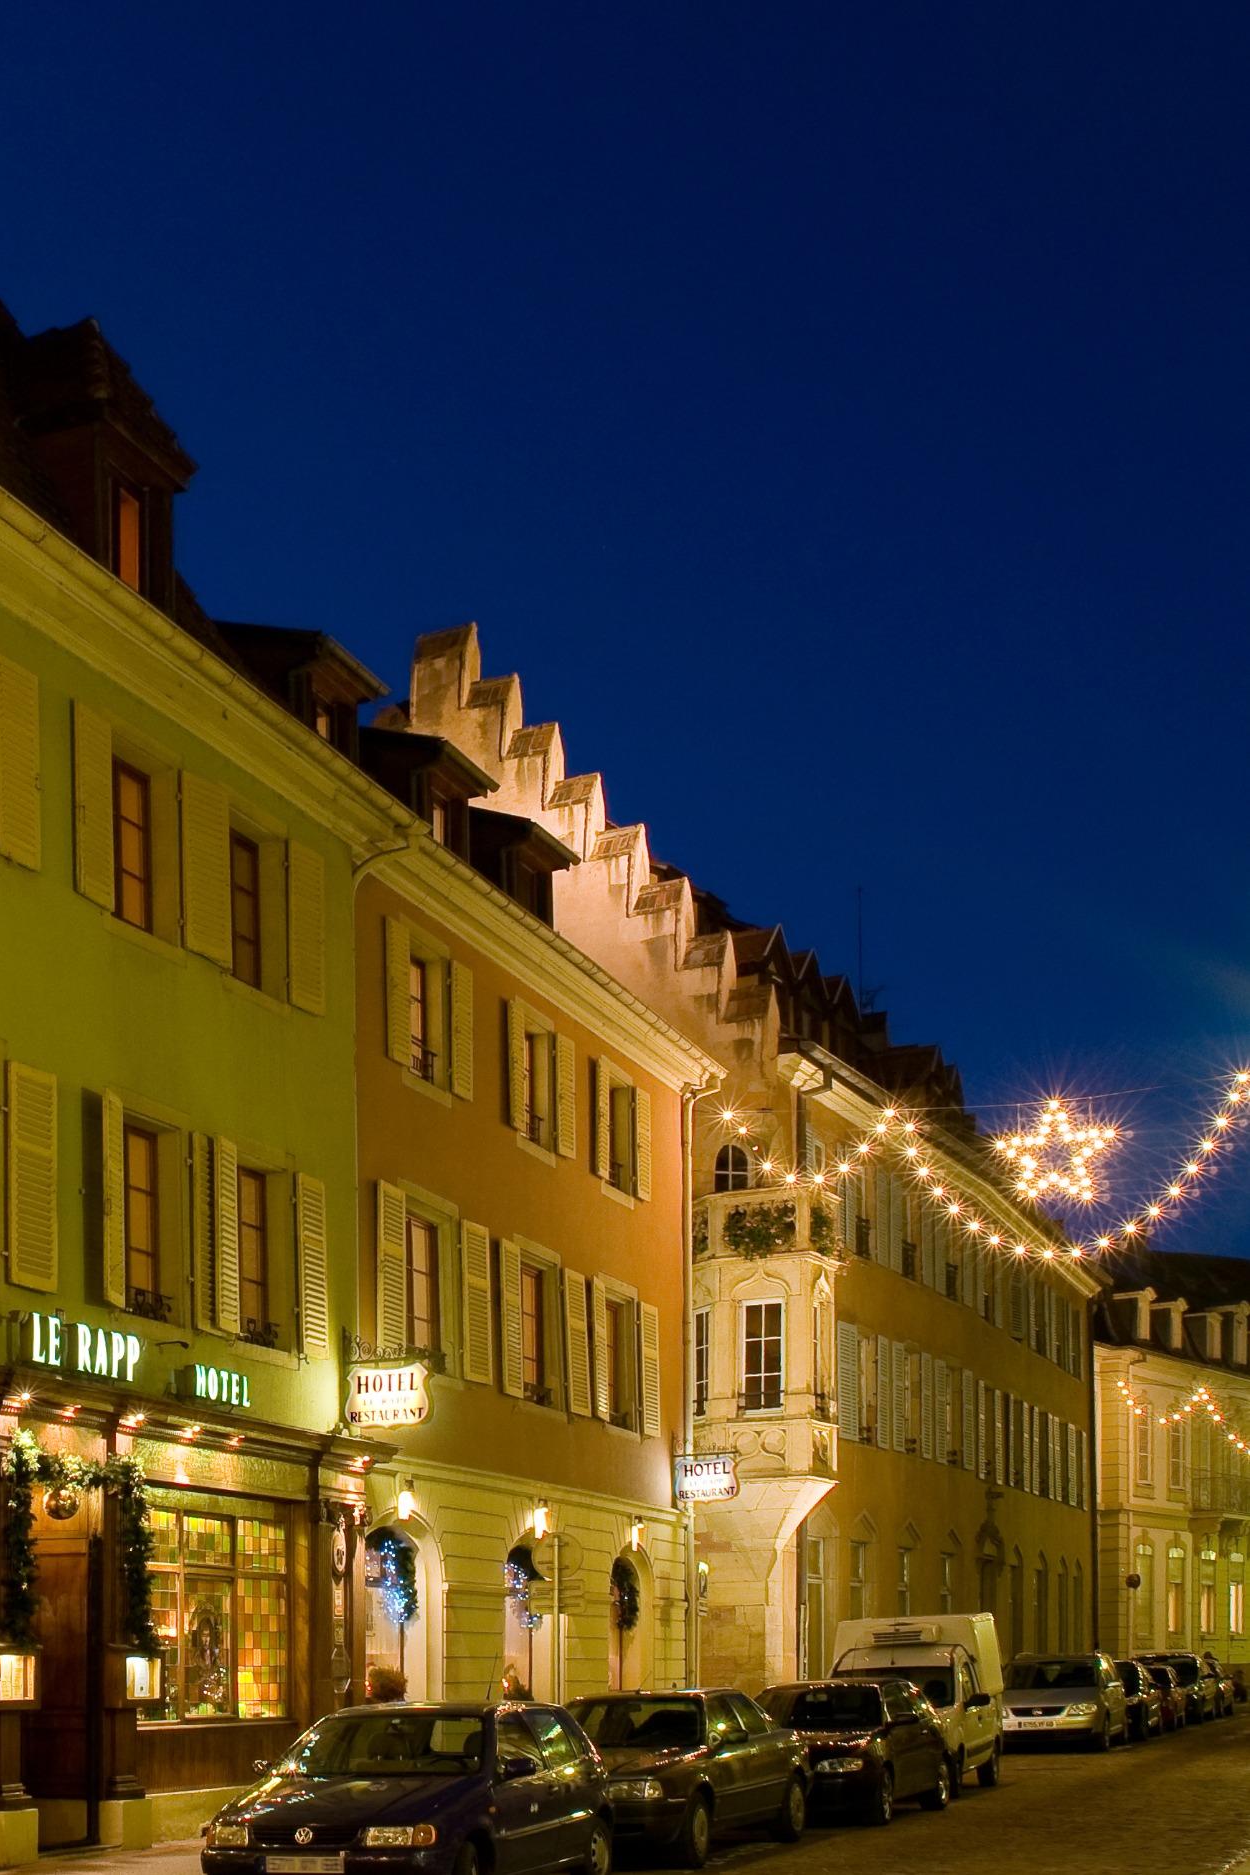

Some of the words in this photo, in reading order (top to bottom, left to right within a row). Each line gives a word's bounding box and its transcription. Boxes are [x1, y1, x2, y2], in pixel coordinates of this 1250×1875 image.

[32, 1312, 62, 1367] LE
[76, 1322, 141, 1382] RAPP
[194, 1363, 251, 1408] HOTEL
[356, 1372, 419, 1394] HOTEL
[350, 1407, 424, 1423] RESTAURANT
[683, 1461, 730, 1477] HOTEL
[678, 1486, 735, 1499] RESTAURANT
